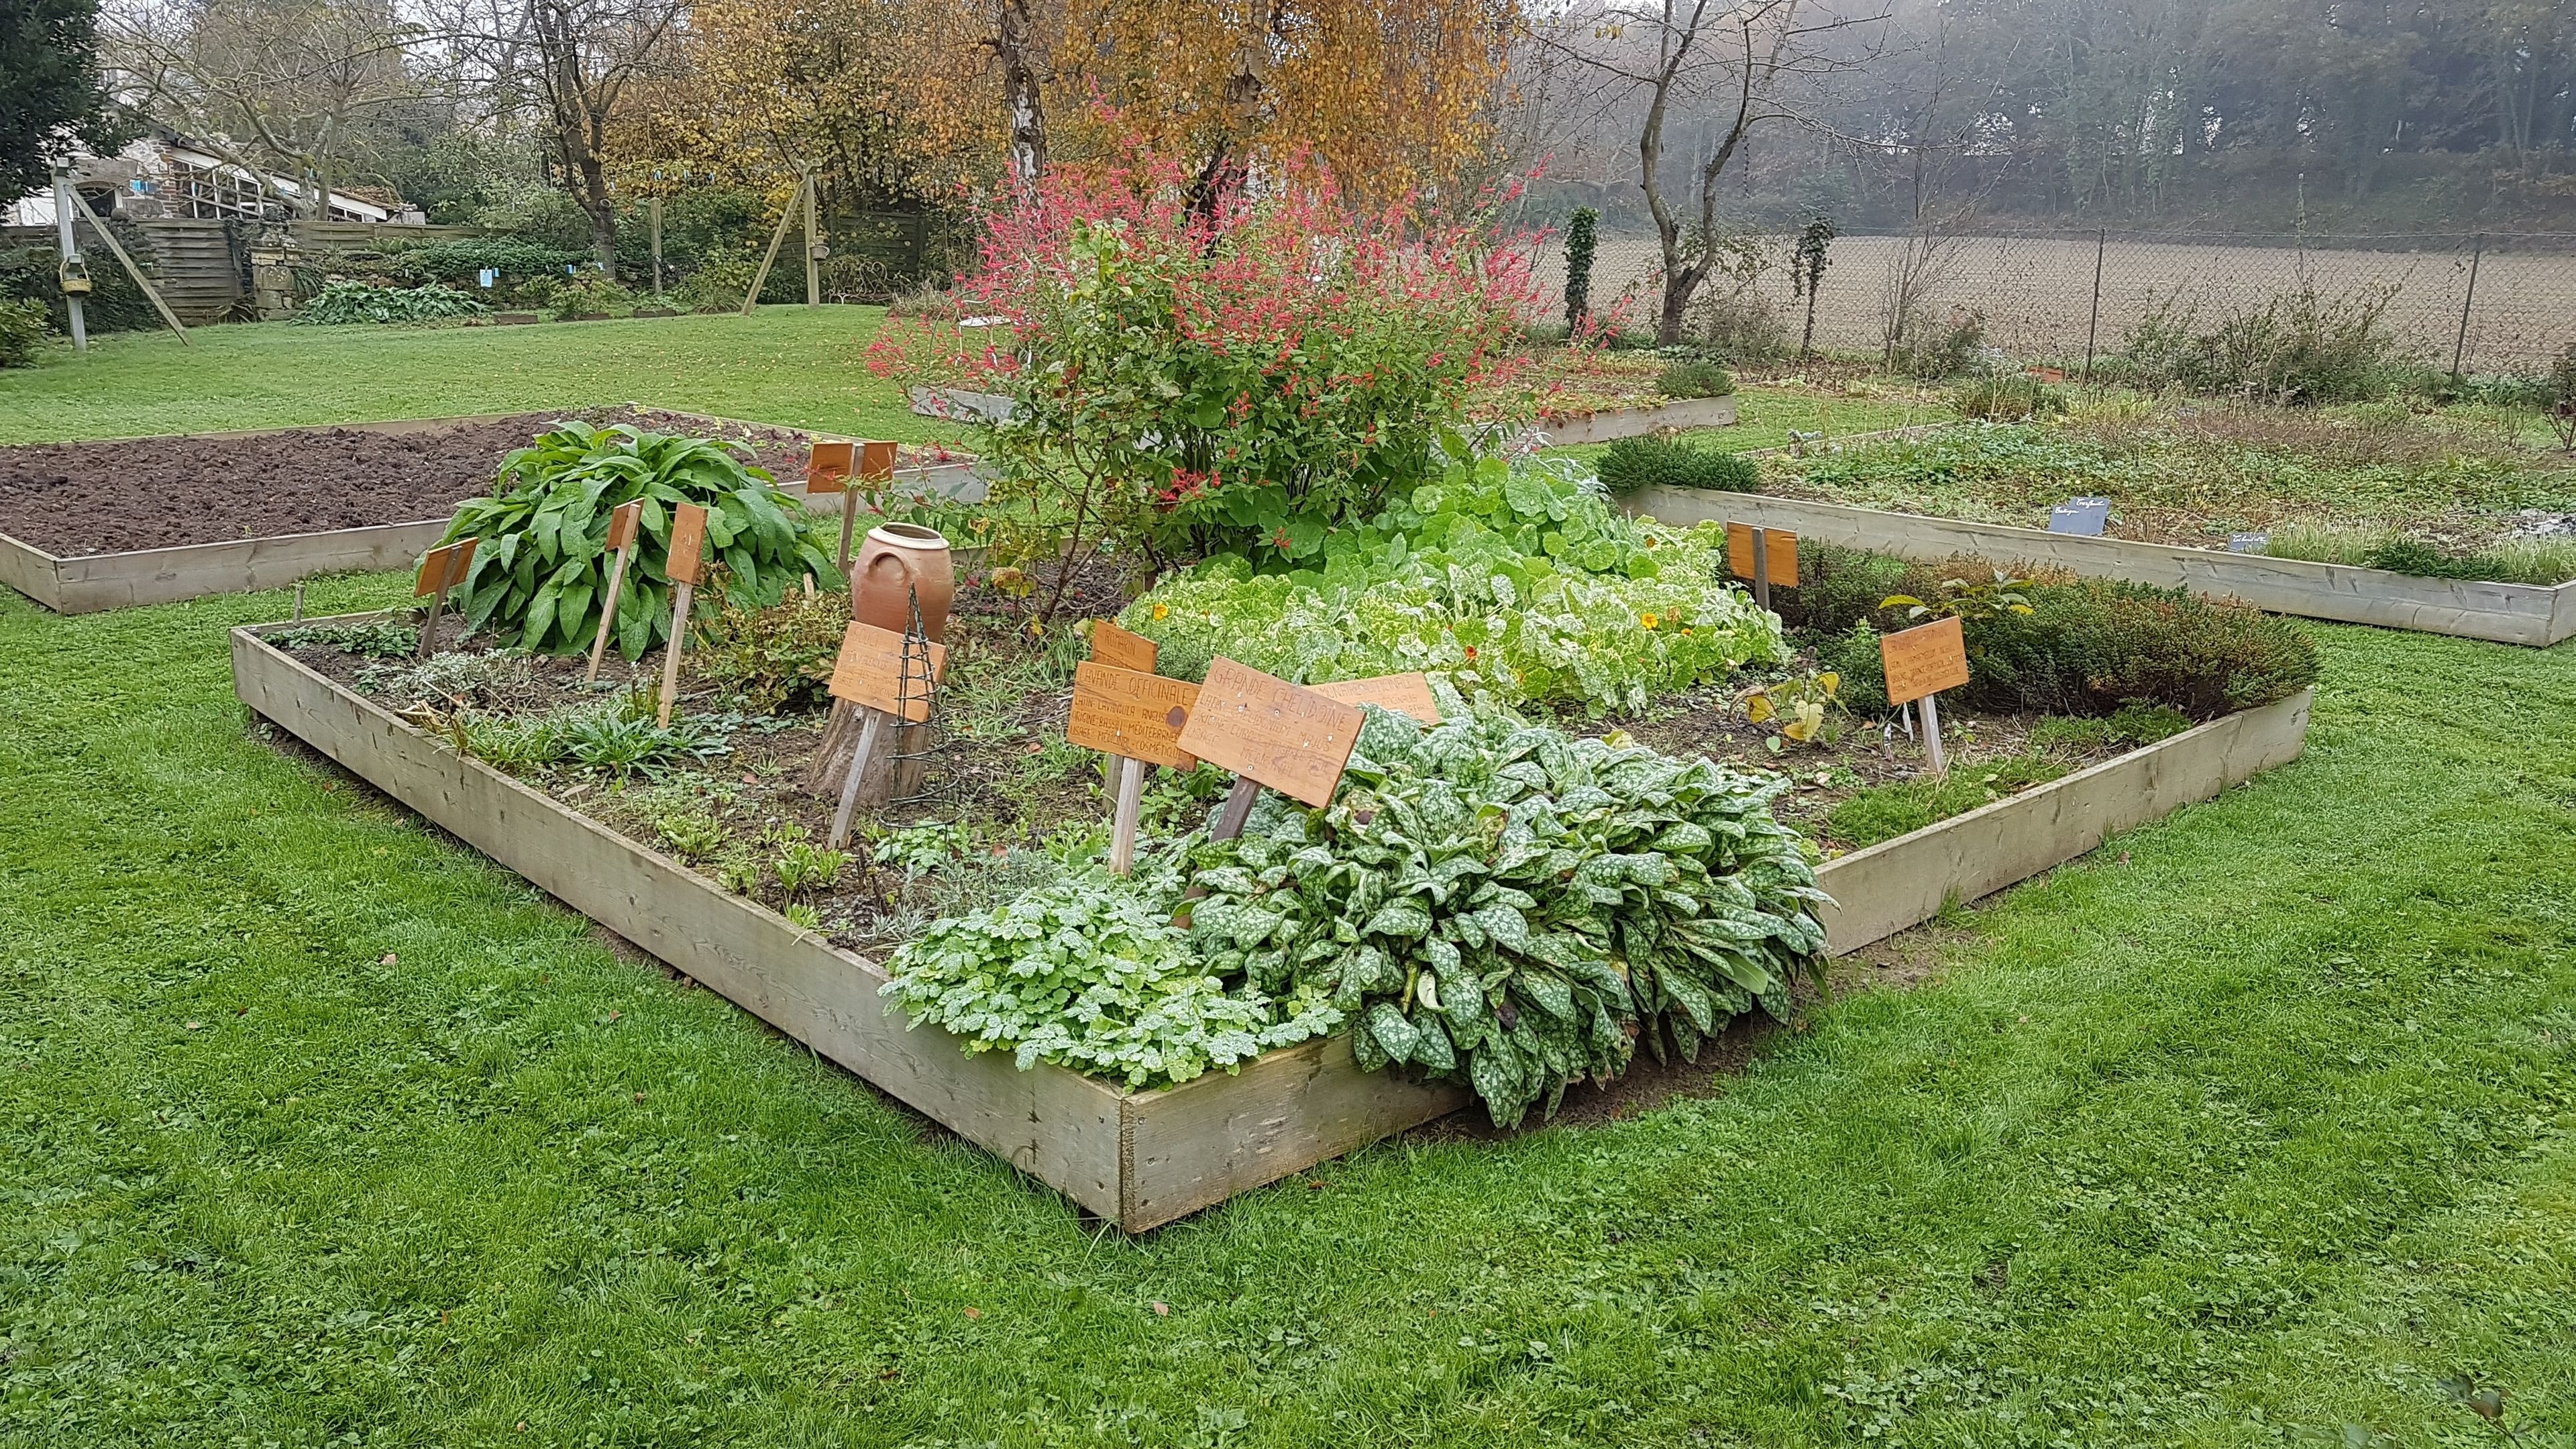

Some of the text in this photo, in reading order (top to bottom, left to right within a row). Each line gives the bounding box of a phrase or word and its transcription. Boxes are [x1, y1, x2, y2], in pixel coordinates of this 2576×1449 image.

[1106, 631, 1135, 654] ROMARIN
[1079, 667, 1189, 704] LAVANDE OFFICINALE
[1213, 665, 1268, 699] GRANDE
[1187, 726, 1219, 747] USAGE
[1297, 731, 1331, 754] MAJUS
